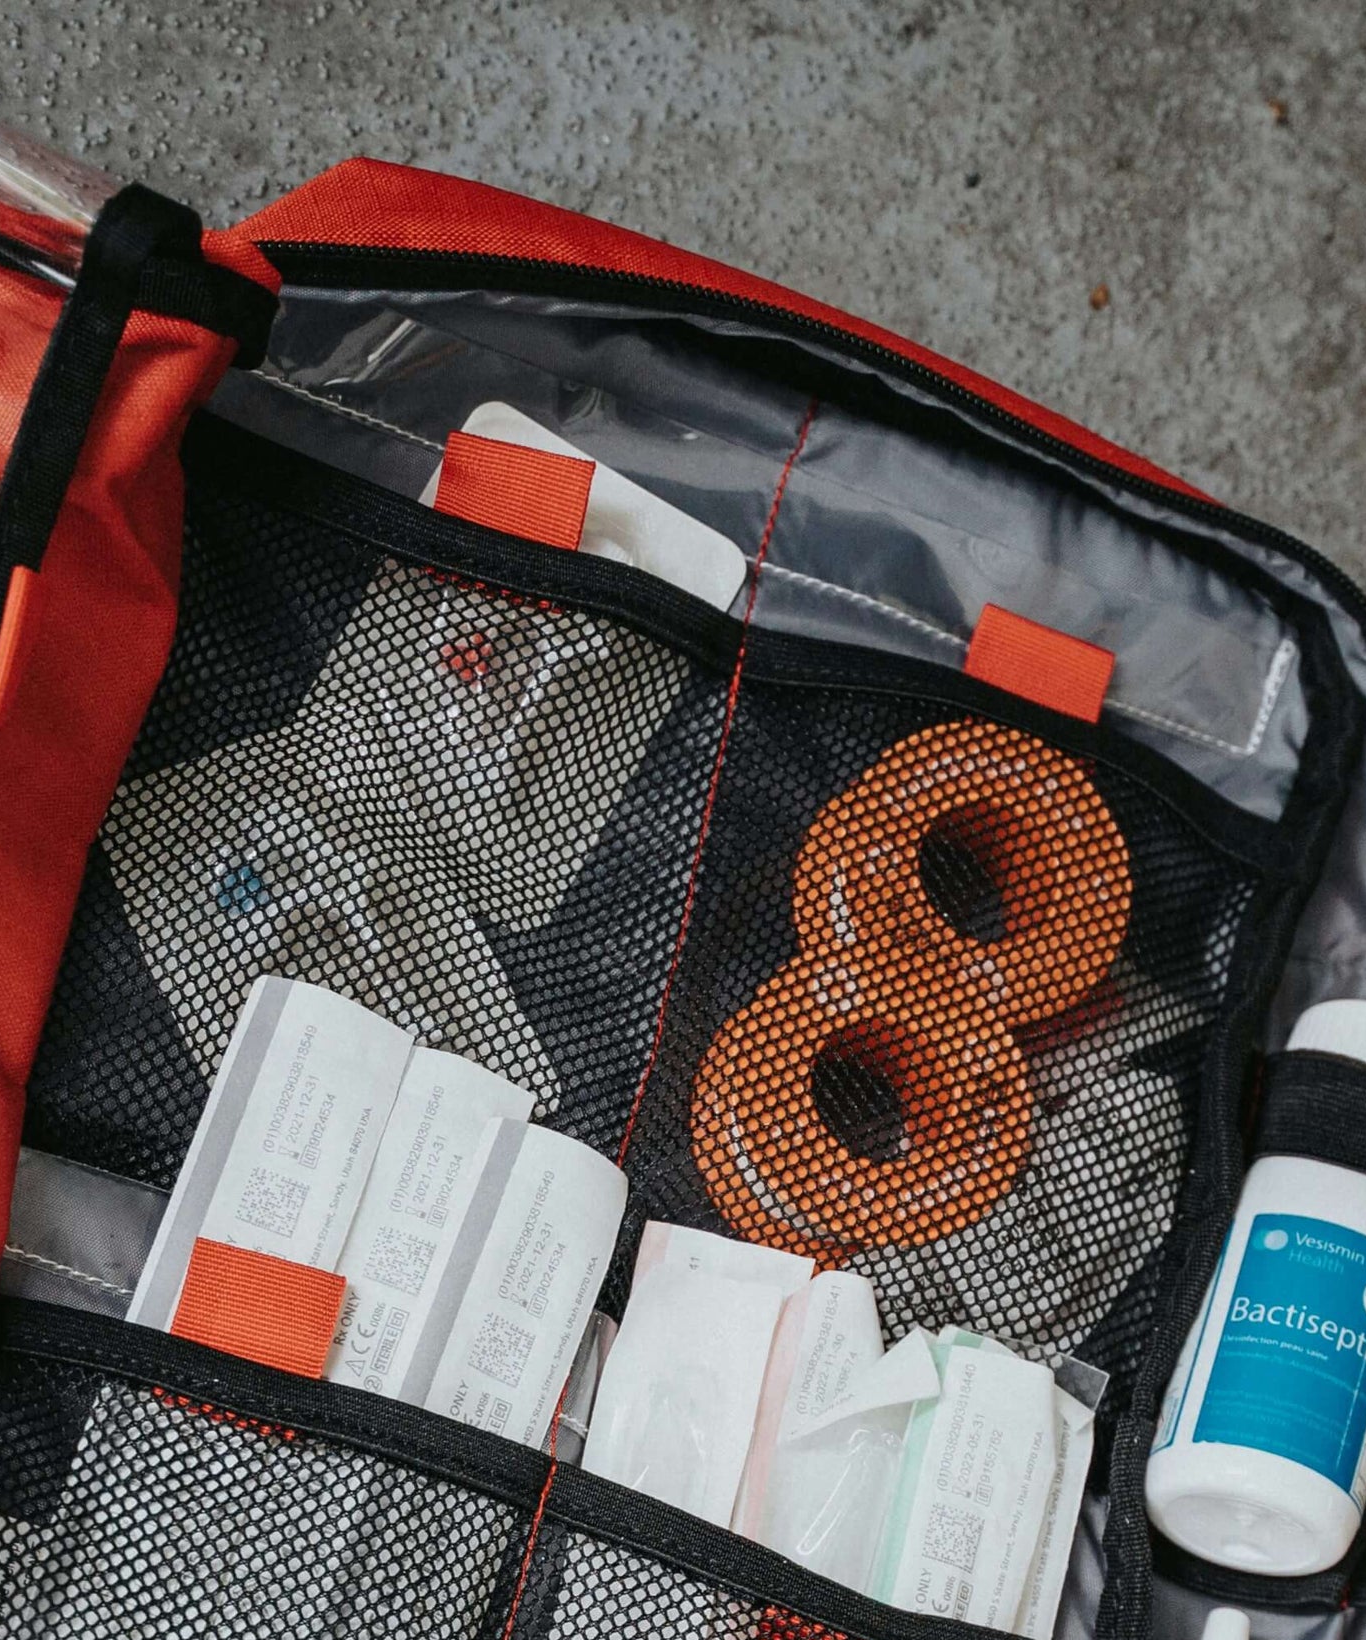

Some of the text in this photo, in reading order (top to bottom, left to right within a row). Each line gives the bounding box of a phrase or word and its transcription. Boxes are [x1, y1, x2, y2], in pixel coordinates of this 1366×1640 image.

[285, 1074, 320, 1144] 2021-12-31
[309, 1092, 337, 1147] 9024534
[349, 1126, 365, 1155] 84070
[412, 1134, 447, 1204] 2021-12-31
[436, 1153, 463, 1206] 9024534
[516, 1221, 553, 1293] 2021-12-31
[536, 1241, 566, 1296] 9024534
[1289, 1248, 1344, 1274] Health
[1295, 1231, 1365, 1265] Vesismin
[332, 1291, 361, 1346] Rx ONLY
[368, 1300, 386, 1327] 0086
[530, 1393, 546, 1418] State
[565, 1305, 579, 1329] Utah
[575, 1276, 590, 1305] 84070
[586, 1255, 598, 1276] USA
[373, 1328, 398, 1371] STERILE
[448, 1379, 470, 1417] ONLY
[472, 1391, 490, 1418] 0086
[957, 1413, 985, 1483] 2022-05-31
[993, 1572, 1006, 1597] State
[1016, 1482, 1029, 1506] Utah
[1036, 1551, 1049, 1575] State
[915, 1568, 932, 1604] ONLY
[941, 1574, 956, 1601] 0086
